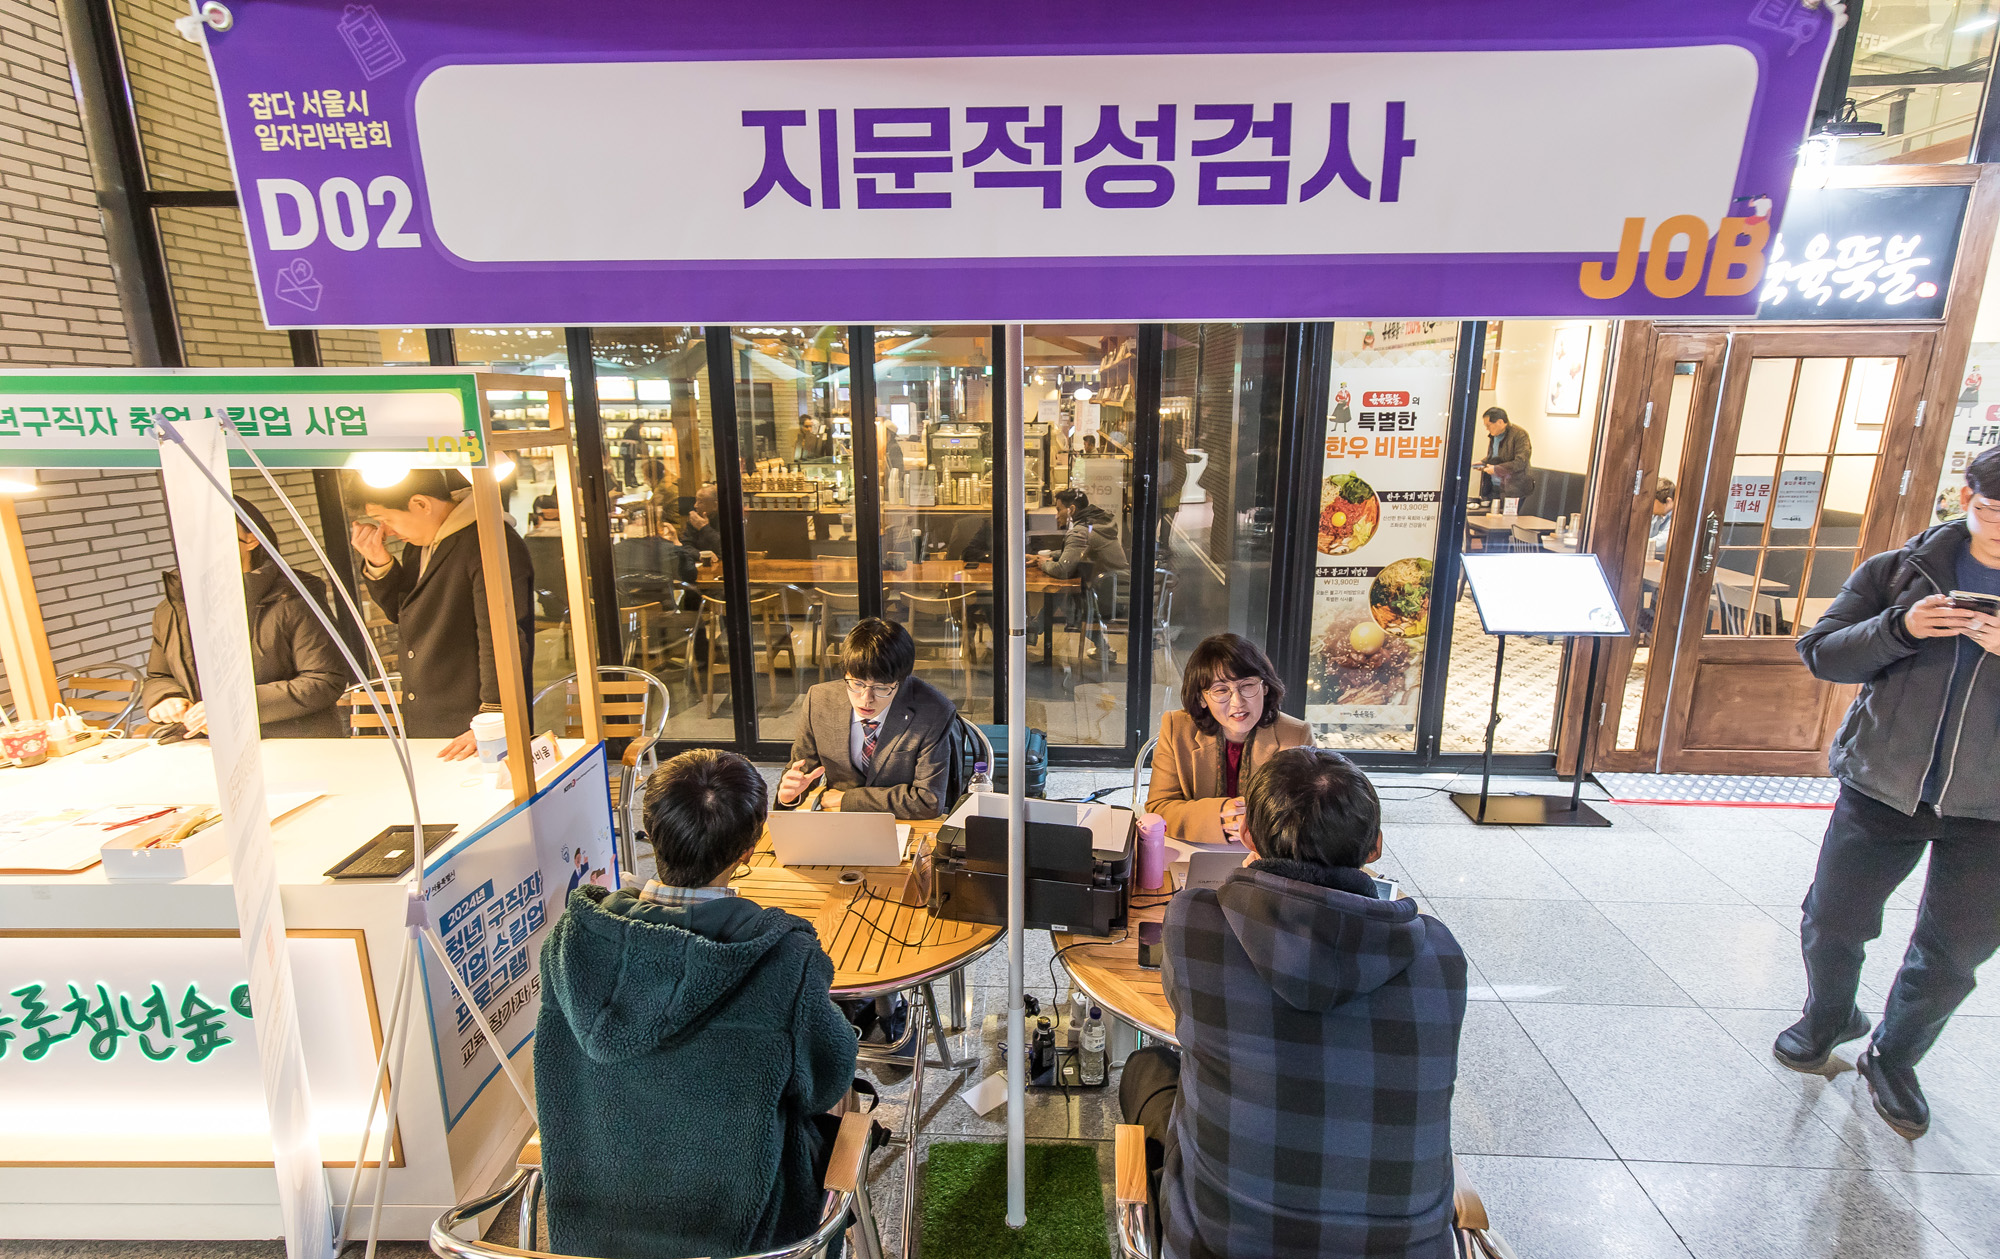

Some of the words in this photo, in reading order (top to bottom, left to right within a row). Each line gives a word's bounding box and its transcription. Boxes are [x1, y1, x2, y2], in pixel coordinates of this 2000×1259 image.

[248, 92, 296, 121] 잡다
[302, 90, 370, 119] 서울시
[255, 121, 393, 151] 일자리박람회
[741, 101, 1417, 210] 지문적성검사
[256, 175, 423, 252] D02
[1579, 214, 1771, 300] JOB
[305, 406, 368, 436] 사업
[1358, 411, 1418, 432] 특별한
[418, 436, 483, 464] JOB
[1325, 436, 1369, 459] 한우
[1374, 436, 1443, 459] 비빔밥
[1730, 483, 1771, 497] 출입문
[445, 914, 485, 967] 청년
[487, 870, 543, 927] 구직자
[448, 887, 486, 928] 2024년
[492, 900, 546, 962] 스킬업
[455, 948, 529, 1034] 프로그램
